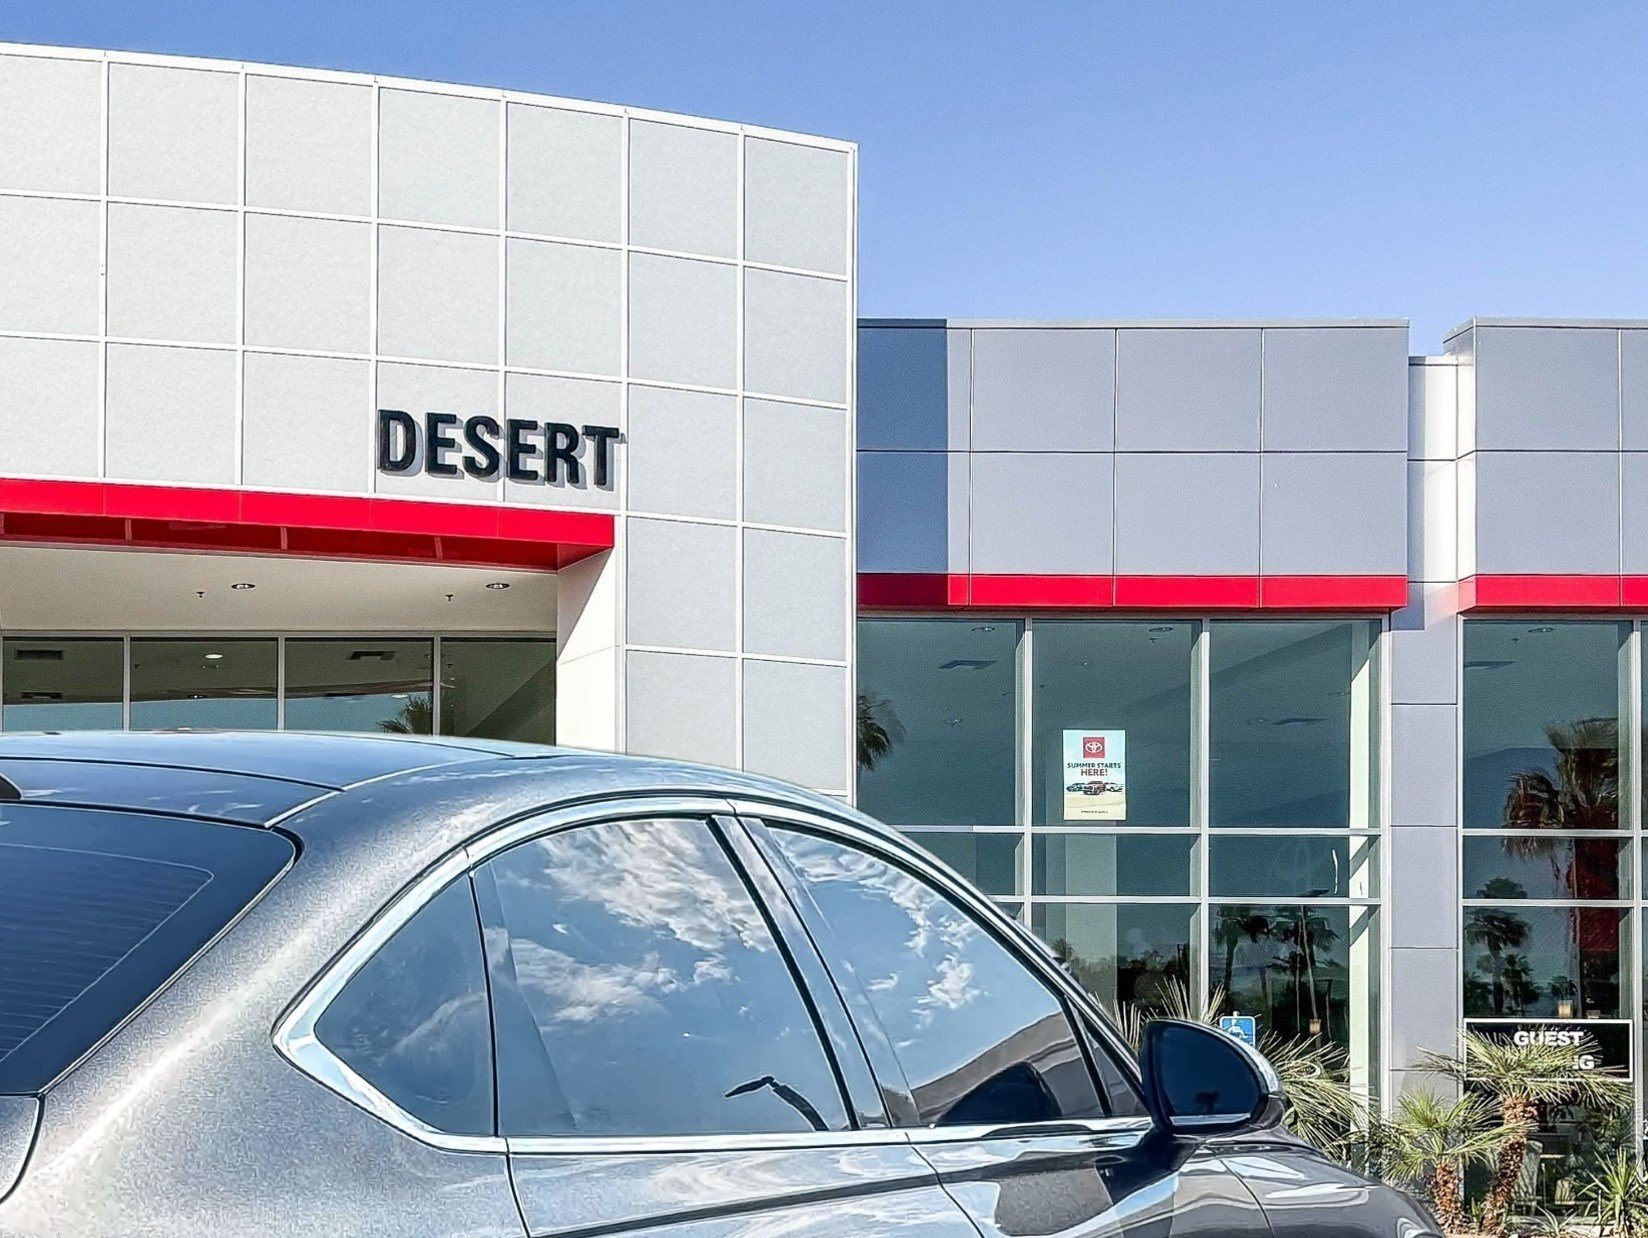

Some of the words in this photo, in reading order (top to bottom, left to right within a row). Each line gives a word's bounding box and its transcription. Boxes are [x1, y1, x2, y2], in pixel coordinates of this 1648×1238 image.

[377, 409, 620, 487] DESERT
[1081, 768, 1108, 777] HERE!
[1513, 1031, 1585, 1047] GUEST
